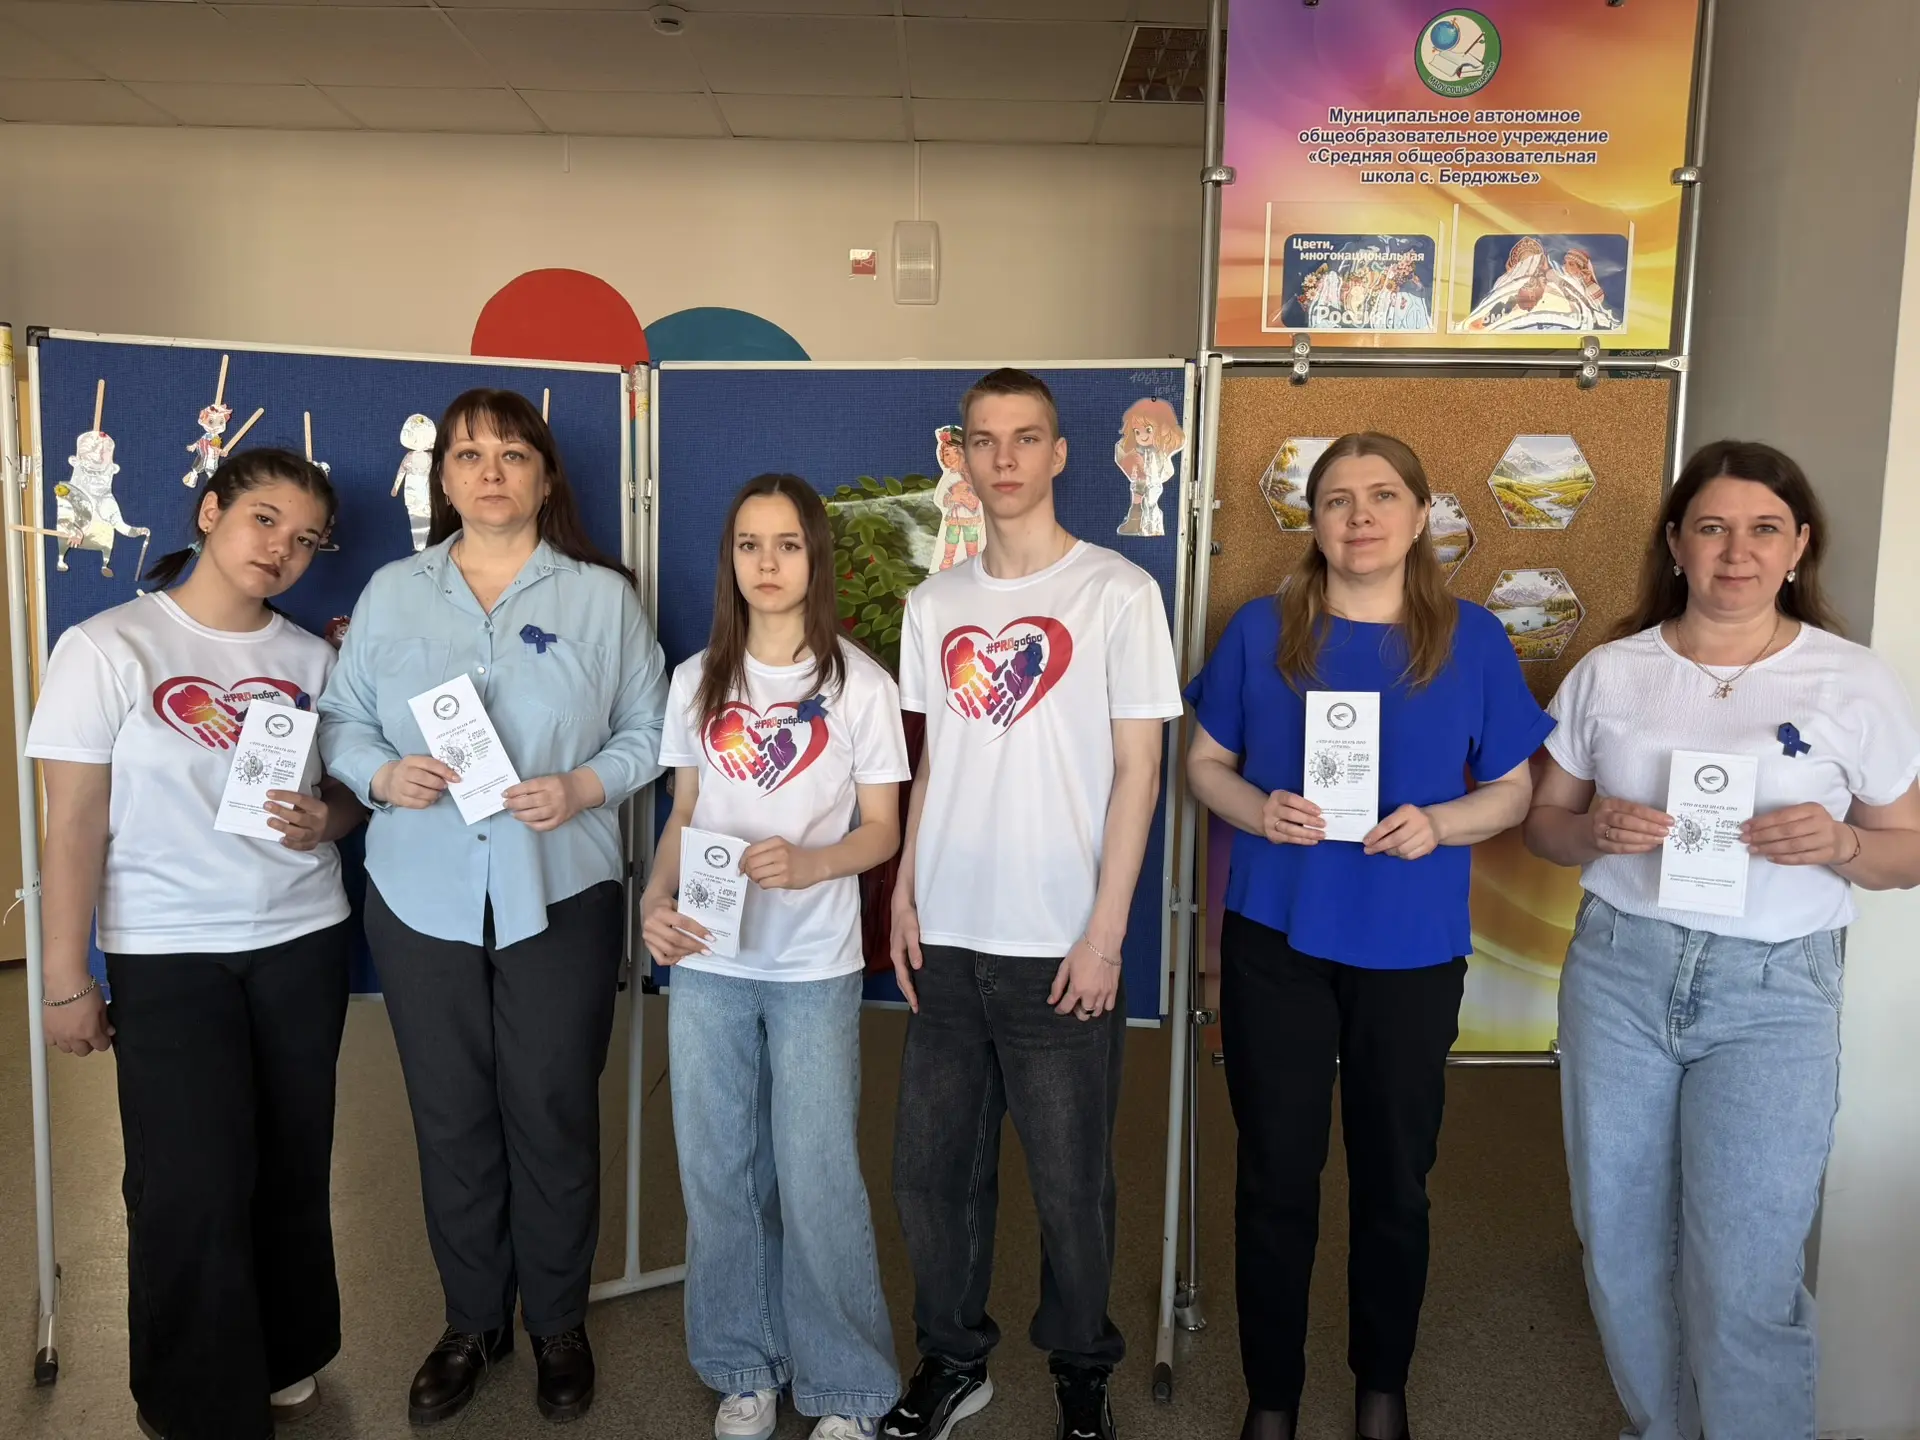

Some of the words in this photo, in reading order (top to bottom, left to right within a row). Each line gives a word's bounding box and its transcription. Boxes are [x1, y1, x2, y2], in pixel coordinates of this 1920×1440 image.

[1328, 107, 1469, 126] Муниципальное
[1475, 110, 1580, 123] автономное
[1299, 127, 1497, 146] общеобразовательное
[1502, 130, 1608, 147] учреждение
[1308, 149, 1392, 166] «Средняя
[1397, 148, 1596, 167] общеобразовательная
[1361, 171, 1415, 183] школа
[1419, 171, 1433, 183] с.
[1439, 167, 1541, 187] Бердюжье»
[1292, 237, 1334, 251] Цвети,
[1300, 251, 1425, 262] многонациональная
